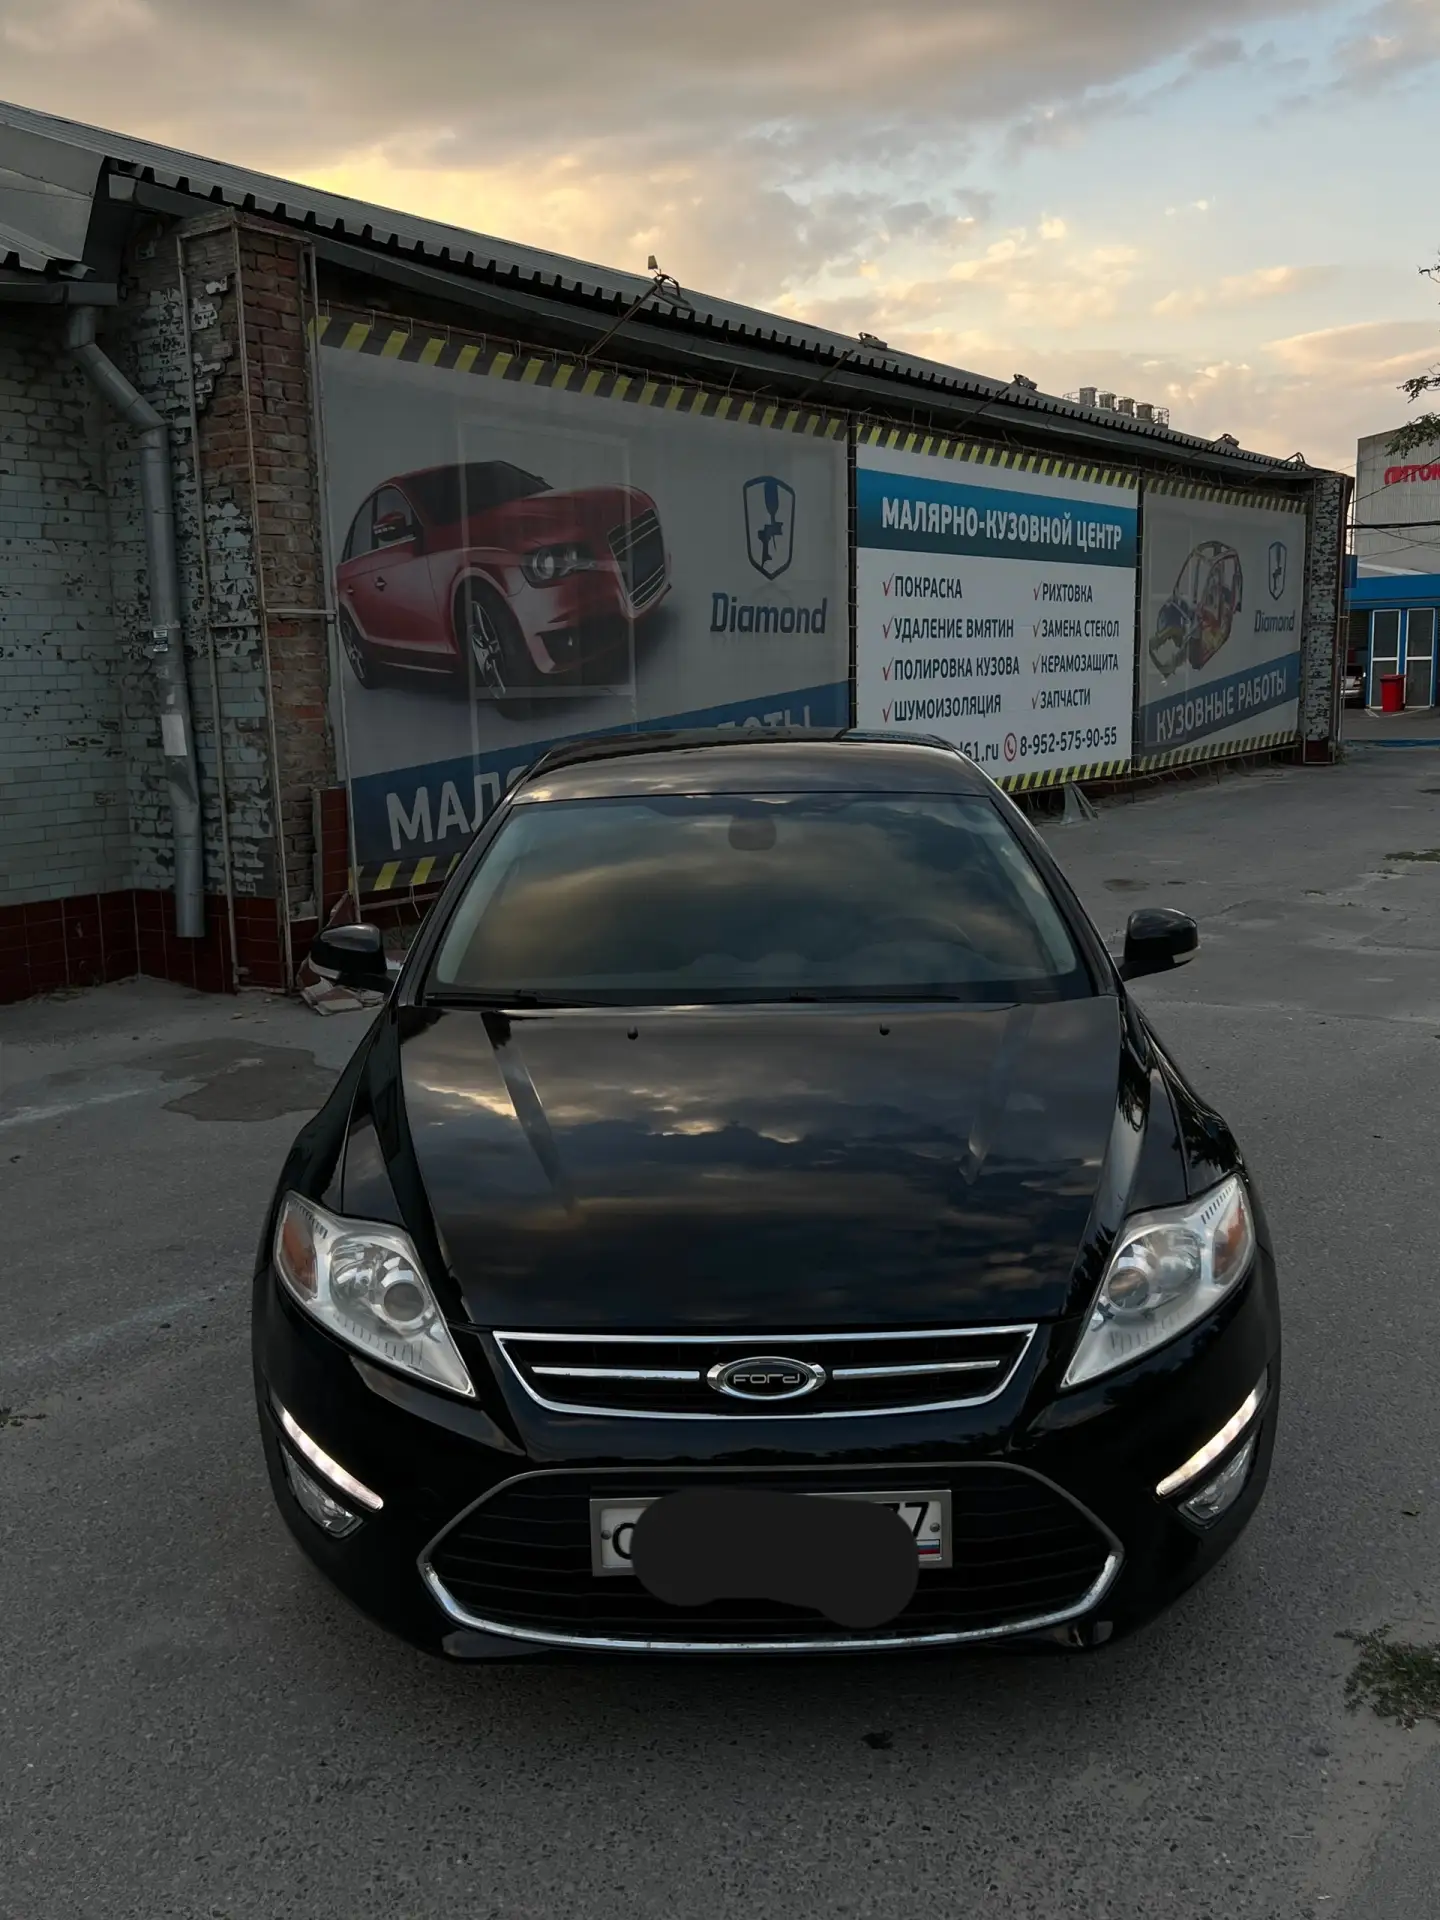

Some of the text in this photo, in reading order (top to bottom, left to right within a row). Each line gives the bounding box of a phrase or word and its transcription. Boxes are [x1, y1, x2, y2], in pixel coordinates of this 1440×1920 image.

[882, 496, 1122, 553] МАЛЯРНО-КУЗОВНОЙ ЦЕНТР
[894, 575, 963, 599] ПОКРАСКА
[1042, 582, 1093, 603] РИХТОВКА
[709, 592, 828, 634] Diamond
[1254, 609, 1296, 633] Diamond
[894, 617, 1014, 643] УДАЛЕНИЕ ВМЯТИН
[1041, 619, 1120, 638] ЗАМЕНА СТЕКОЛ
[894, 656, 1020, 681] ПОЛИРОВКА КУЗОВА
[1040, 653, 1119, 674] КЕРАМОЗАЩИТА
[894, 694, 1002, 722] ШУМОИЗОЛЯЦИЯ
[1040, 688, 1091, 709] ЗАПЧАСТИ
[1156, 667, 1287, 743] КУЗОВНЫЕ РАБОТЫ
[1019, 726, 1117, 757] 8-952-575-90-55
